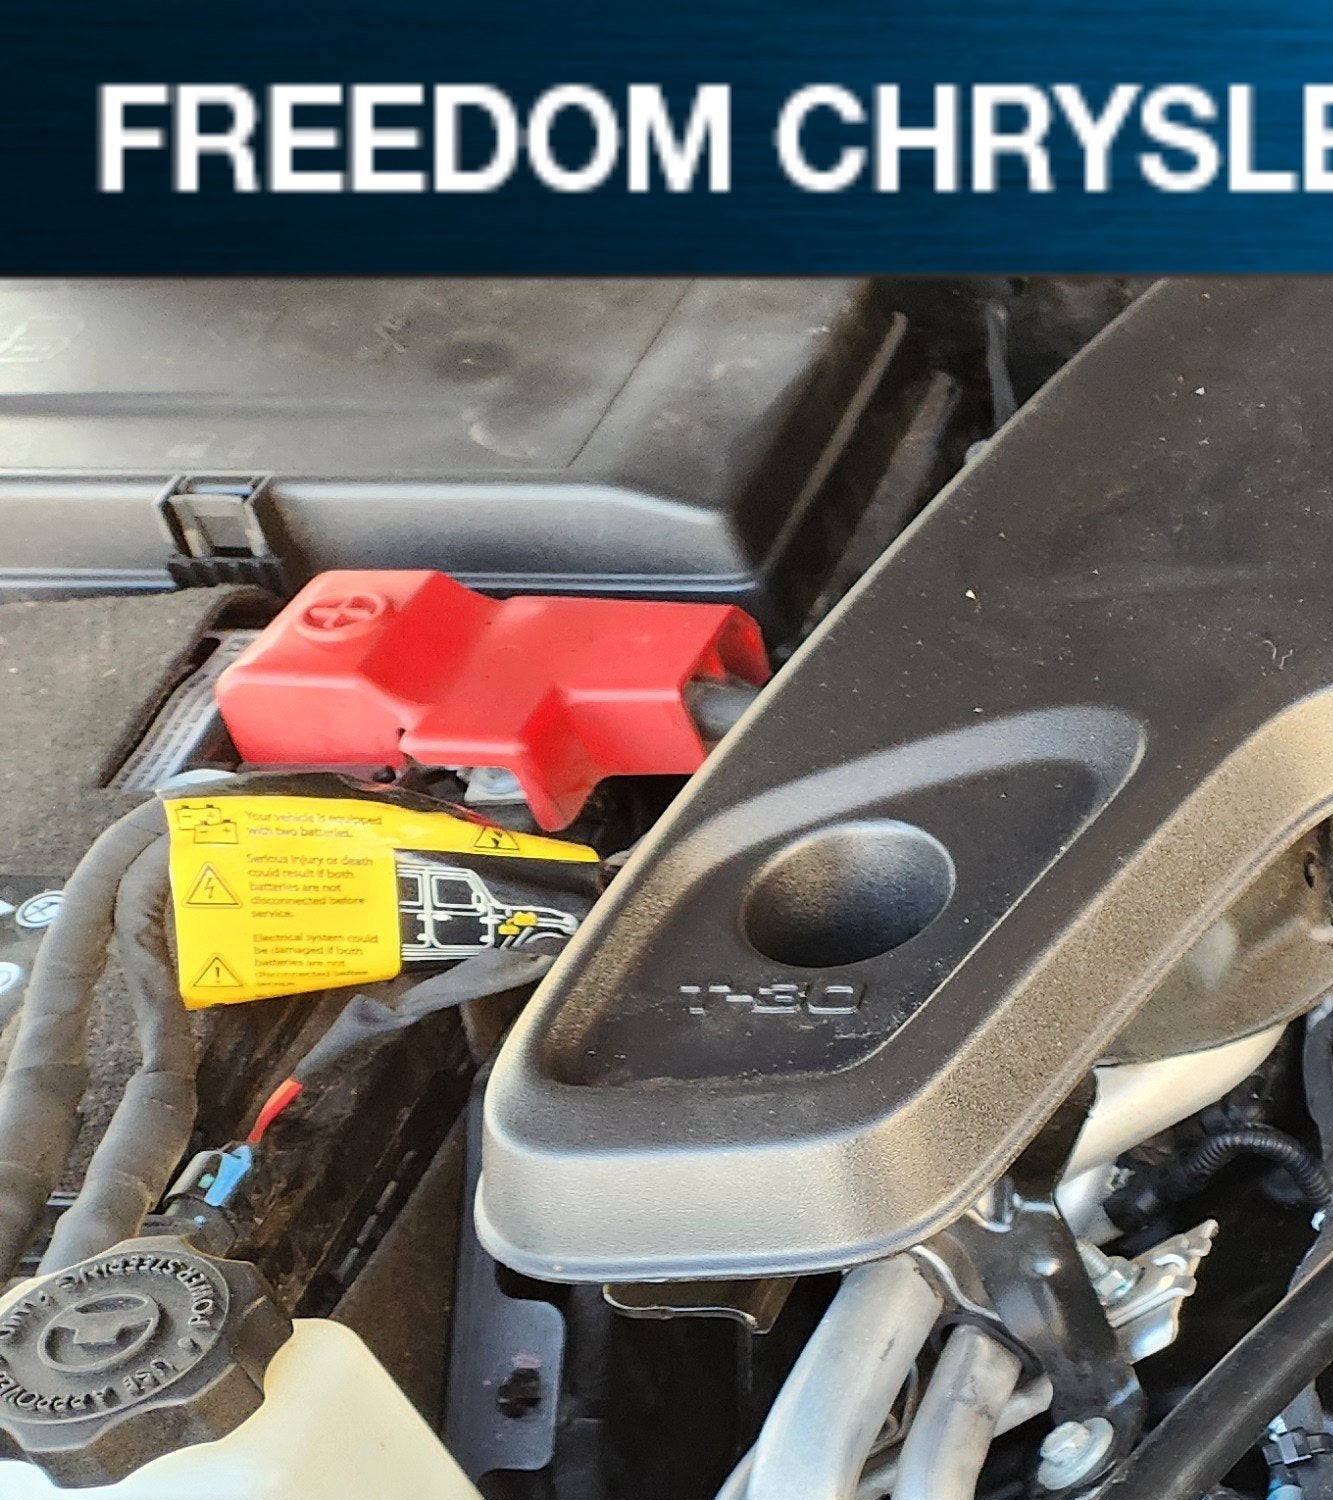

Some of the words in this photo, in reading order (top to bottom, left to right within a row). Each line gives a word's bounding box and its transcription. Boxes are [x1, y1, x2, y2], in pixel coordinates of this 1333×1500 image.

[245, 811, 271, 821] Your
[276, 812, 314, 823] vehicle
[248, 826, 272, 836] with
[276, 827, 297, 837] two
[246, 853, 288, 865] Serious
[341, 855, 373, 866] death
[248, 868, 280, 878] could
[283, 869, 315, 878] result
[327, 870, 354, 879] both
[250, 882, 298, 892] batteries
[302, 884, 319, 892] are
[323, 883, 341, 892] not
[250, 896, 327, 905] disconnected
[330, 896, 364, 905] before
[347, 934, 378, 943] could
[177, 1266, 214, 1328] POWER
[122, 1357, 177, 1396] USE
